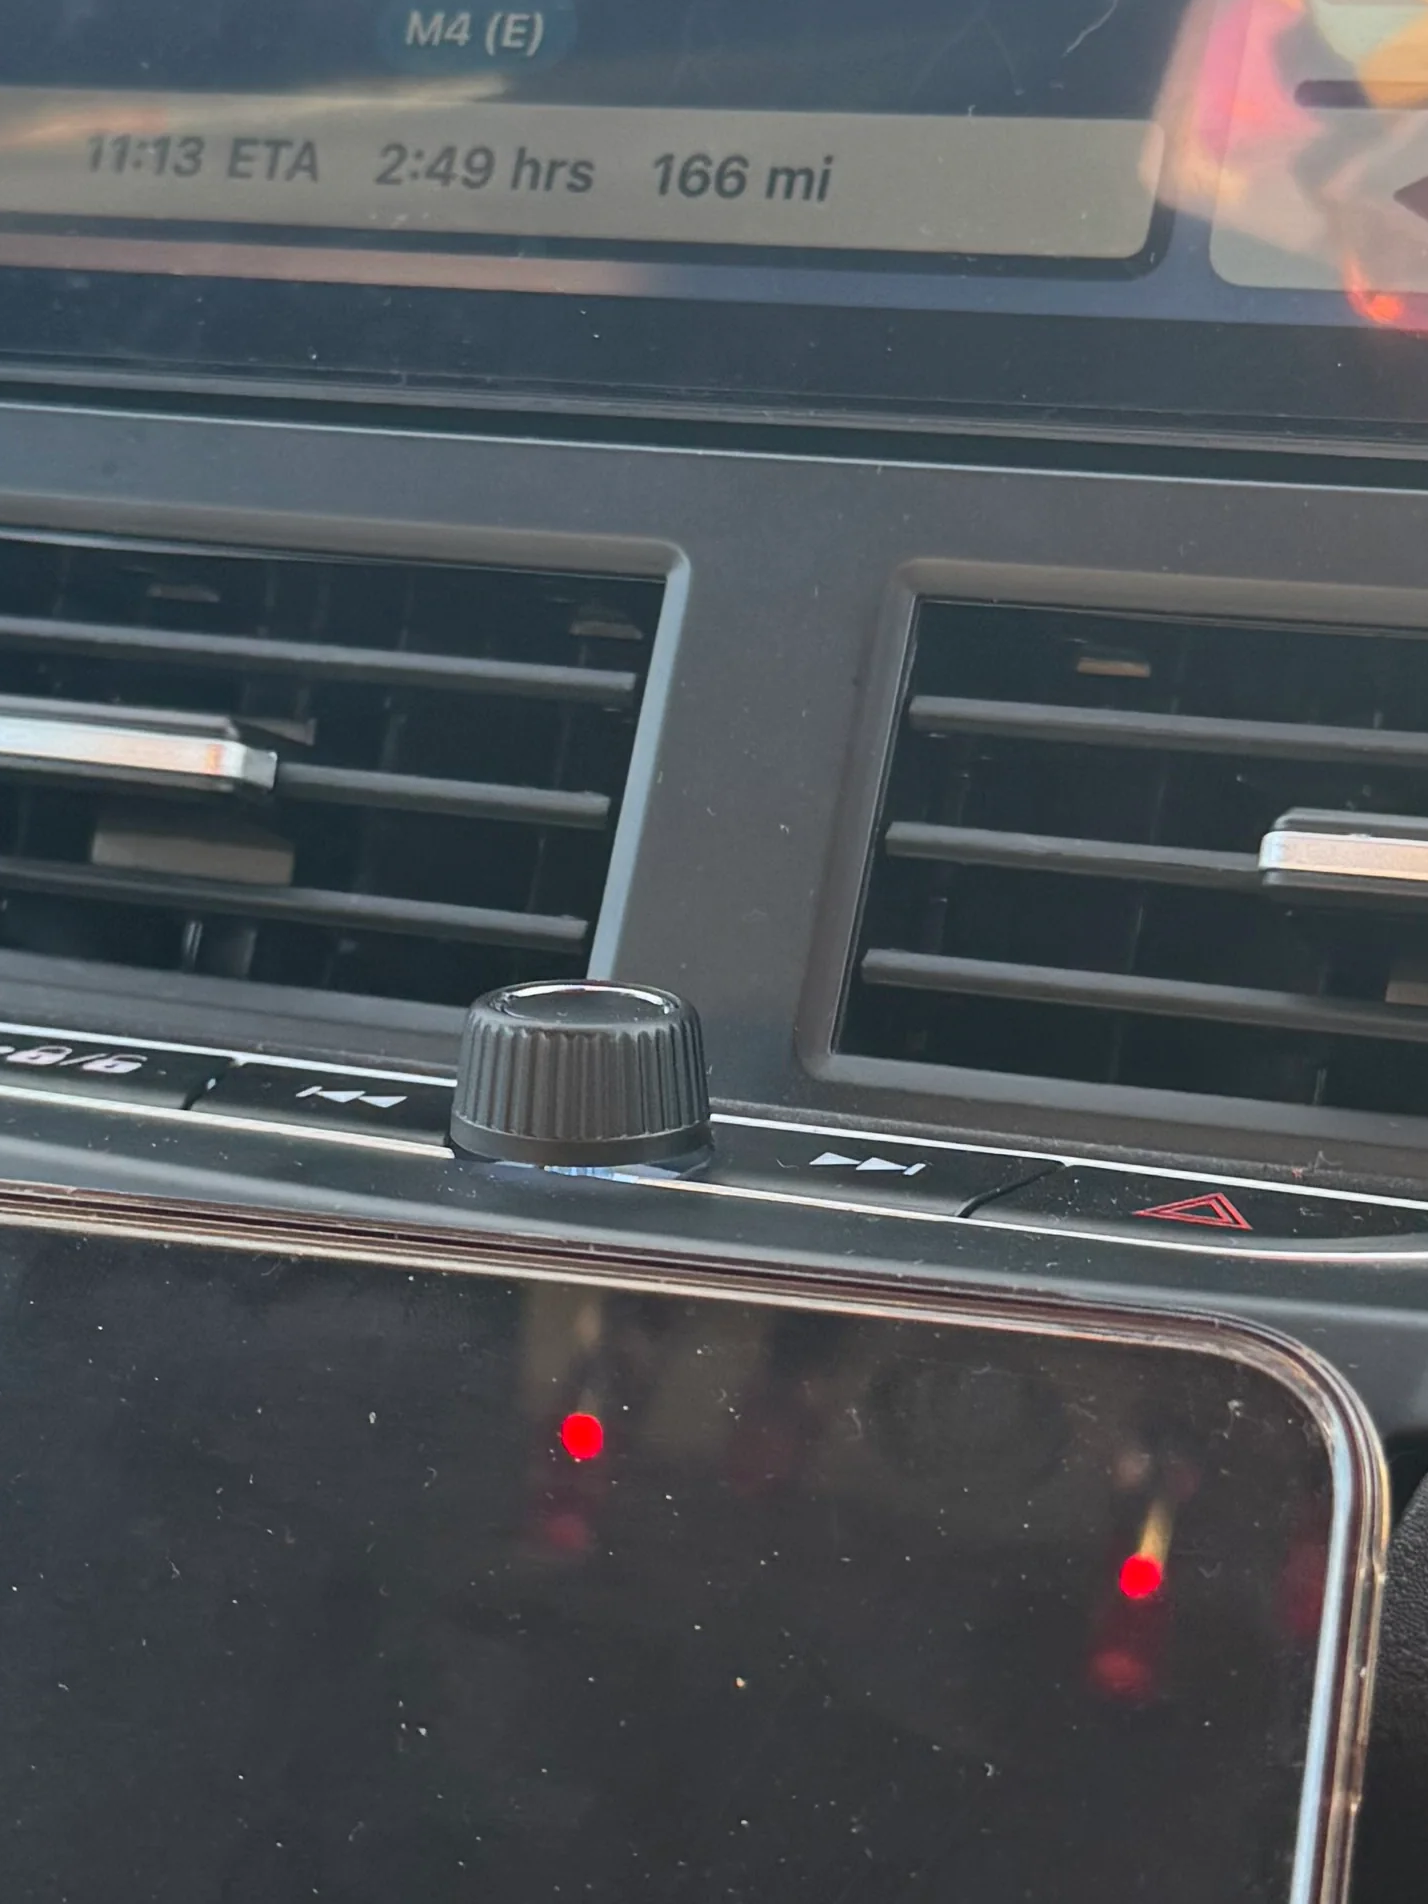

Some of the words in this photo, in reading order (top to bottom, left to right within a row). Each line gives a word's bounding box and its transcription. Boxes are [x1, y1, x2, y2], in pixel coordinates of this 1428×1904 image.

[404, 10, 471, 47] M4
[484, 11, 545, 58] (E)
[86, 131, 204, 179] 11:13
[225, 137, 321, 184] ETA
[374, 142, 494, 192] 2:49
[510, 145, 596, 196] hrs
[651, 151, 748, 201] 166
[765, 154, 836, 205] mi
